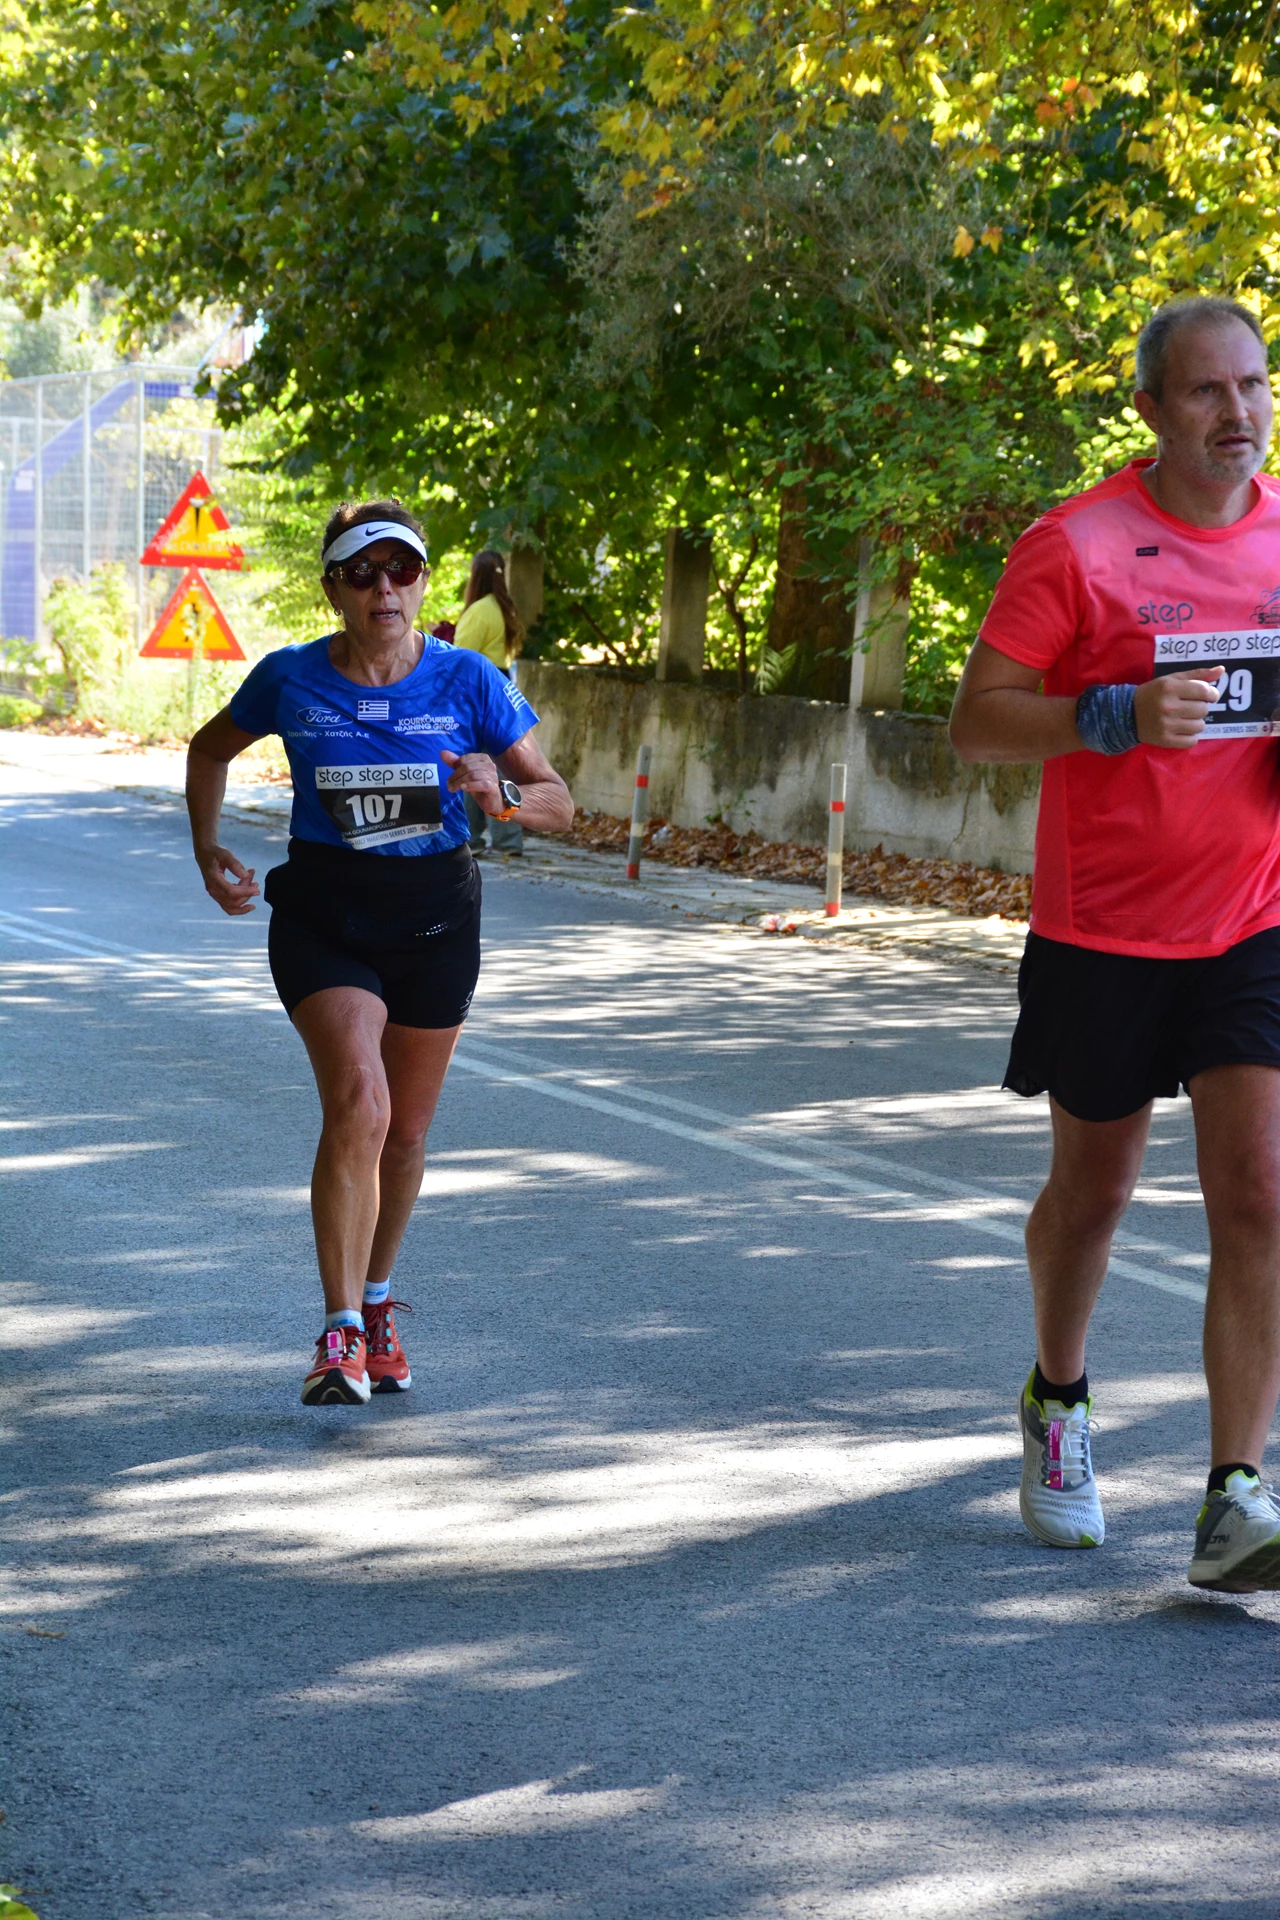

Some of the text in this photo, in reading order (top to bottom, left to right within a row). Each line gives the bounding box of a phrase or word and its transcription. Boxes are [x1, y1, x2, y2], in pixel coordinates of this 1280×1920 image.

[1137, 600, 1193, 629] step
[1159, 633, 1280, 659] step step step
[306, 709, 341, 723] Ford
[398, 715, 455, 726] KOURKOURIKIS
[324, 730, 354, 739] Χατζής
[393, 722, 460, 732] TRAINING GROUP
[319, 766, 434, 787] step step step
[345, 794, 403, 827] 107
[366, 832, 389, 843] MARATHON
[388, 828, 407, 839] SERRES
